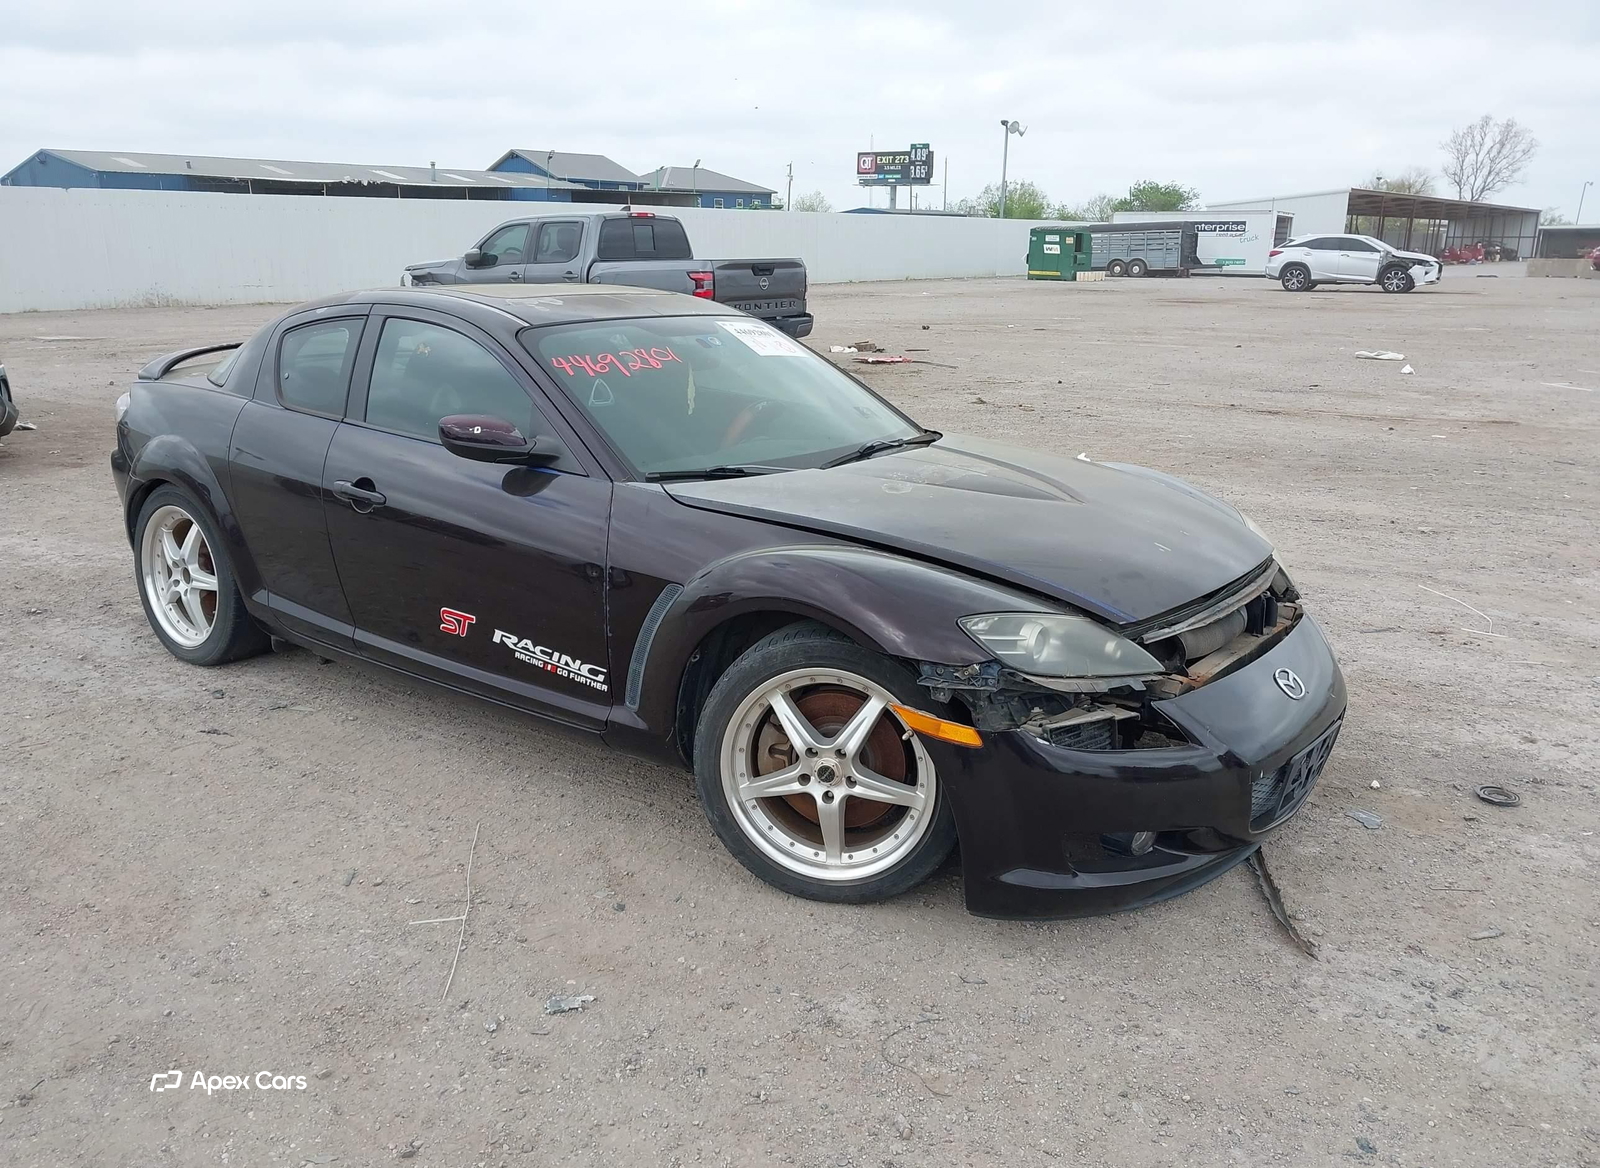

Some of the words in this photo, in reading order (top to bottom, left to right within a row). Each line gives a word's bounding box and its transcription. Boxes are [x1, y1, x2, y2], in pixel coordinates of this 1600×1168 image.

[860, 157, 873, 170] QT
[877, 156, 894, 164] EXIT
[894, 155, 909, 164] 273
[1194, 221, 1246, 233] nterprise
[730, 300, 797, 312] RONTIER
[551, 345, 683, 377] 44692801
[439, 607, 476, 637] ST
[492, 628, 608, 683] RACING
[514, 651, 544, 669] RACING
[556, 668, 568, 678] GO
[569, 673, 608, 692] FURTHER
